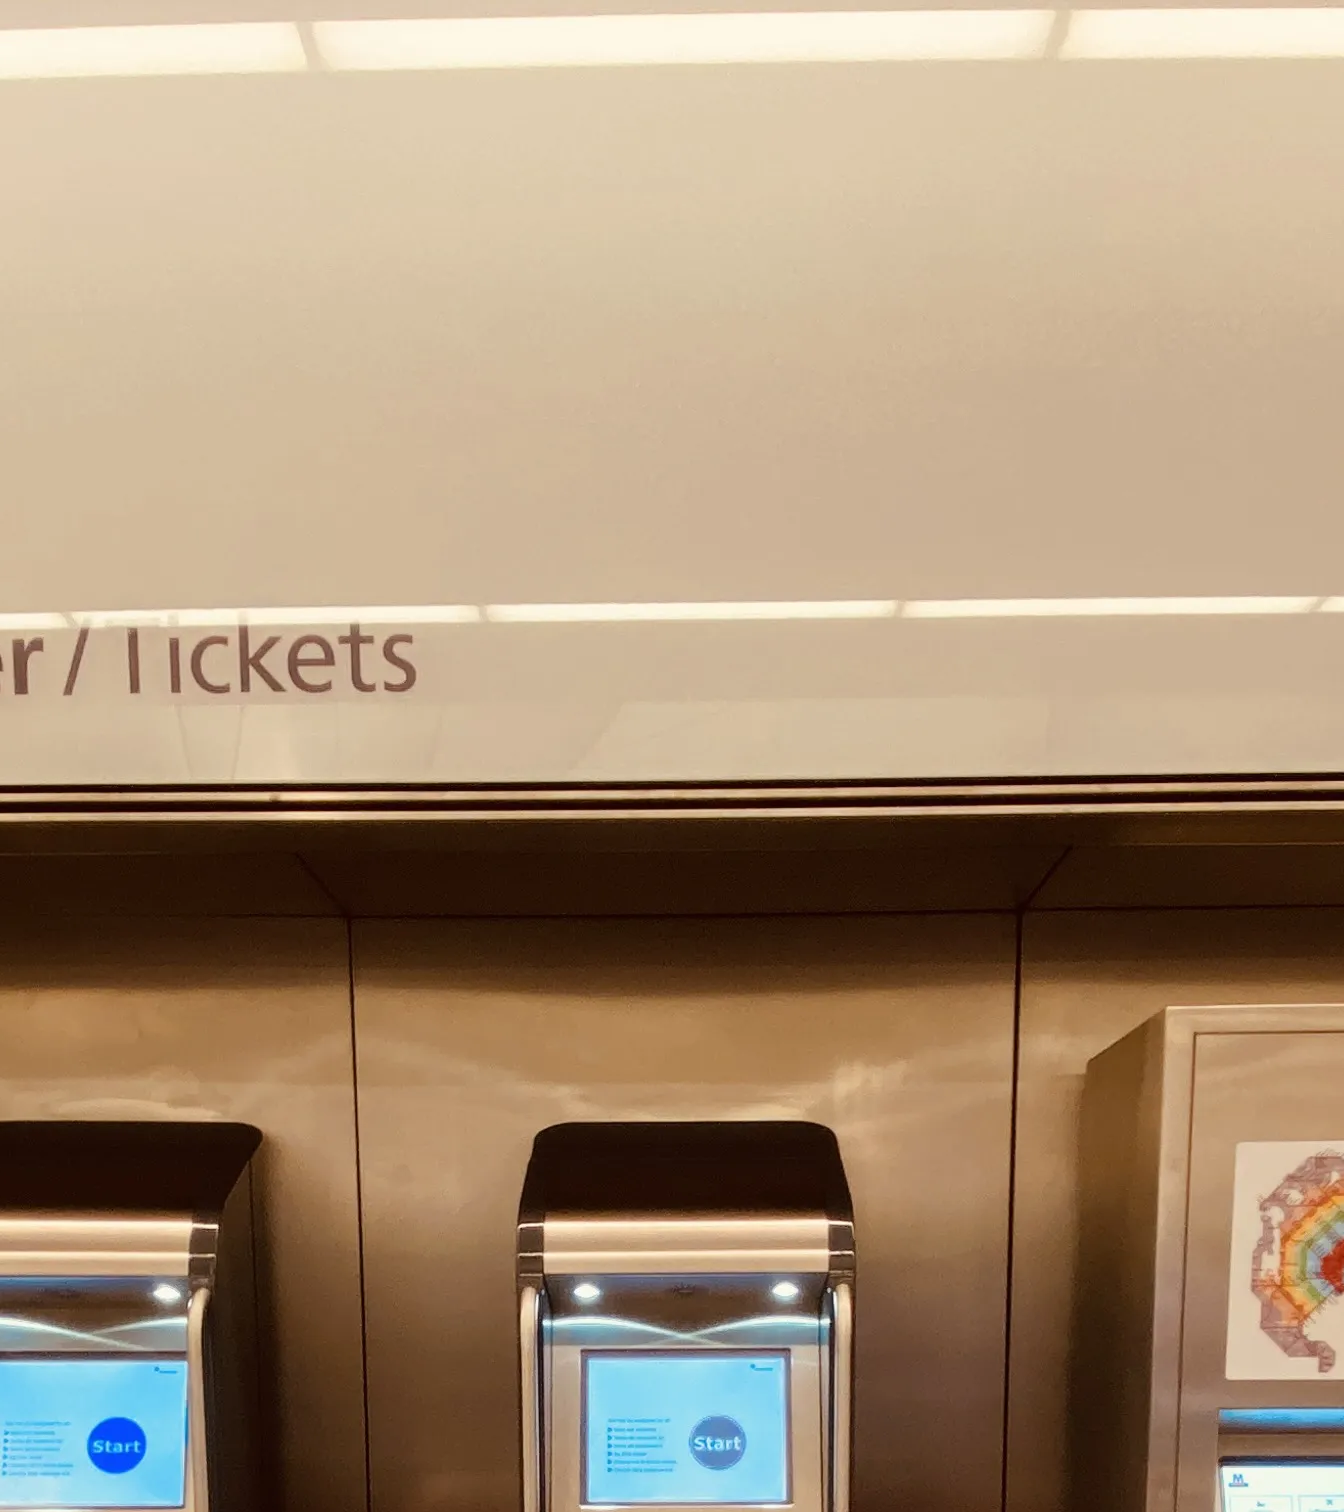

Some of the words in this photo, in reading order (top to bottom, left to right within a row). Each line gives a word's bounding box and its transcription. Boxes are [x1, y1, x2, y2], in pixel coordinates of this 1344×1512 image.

[104, 611, 418, 696] Tickets
[92, 1439, 142, 1454] Start
[693, 1435, 742, 1451] Start
